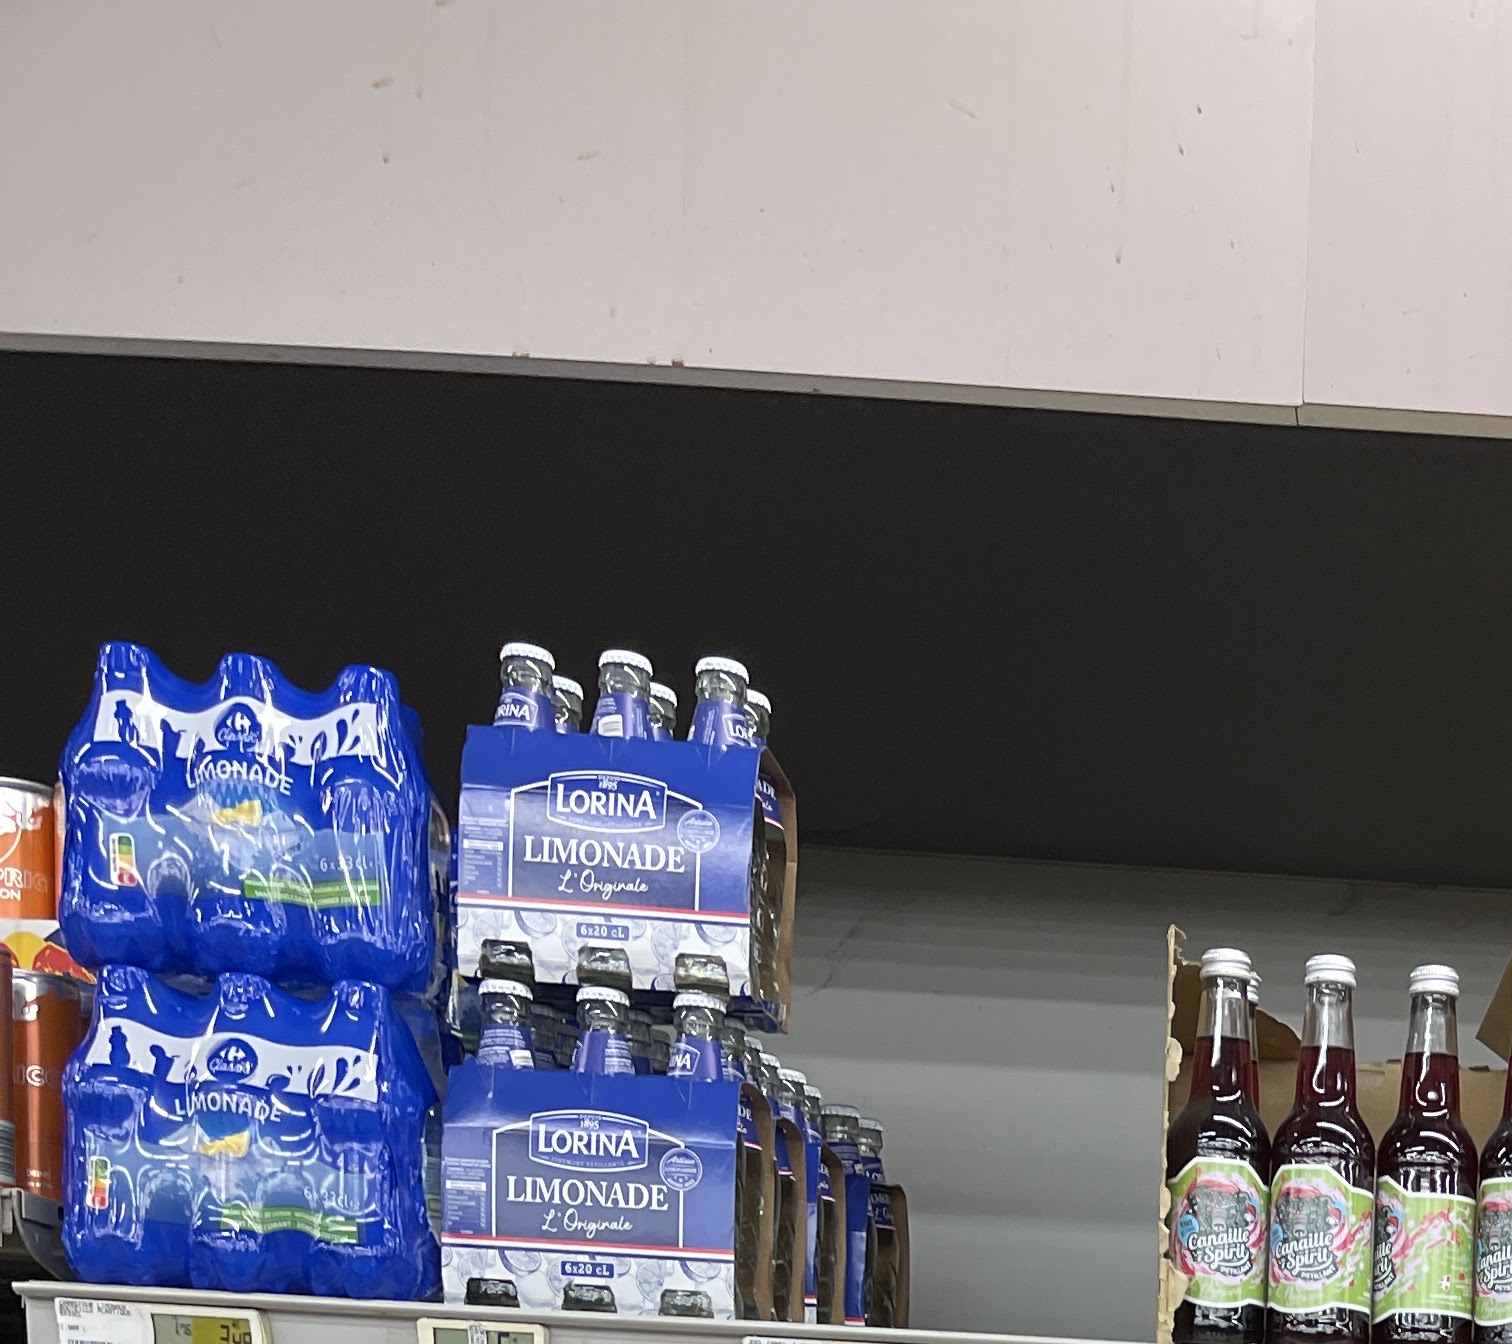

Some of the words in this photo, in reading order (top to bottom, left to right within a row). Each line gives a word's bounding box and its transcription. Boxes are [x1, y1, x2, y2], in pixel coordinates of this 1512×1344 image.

[554, 790, 658, 821] LORINA
[522, 836, 686, 873] LIMONADE
[558, 870, 649, 895] L'Originale
[538, 1129, 639, 1158] LORINA
[506, 1175, 669, 1211] LIMONADE
